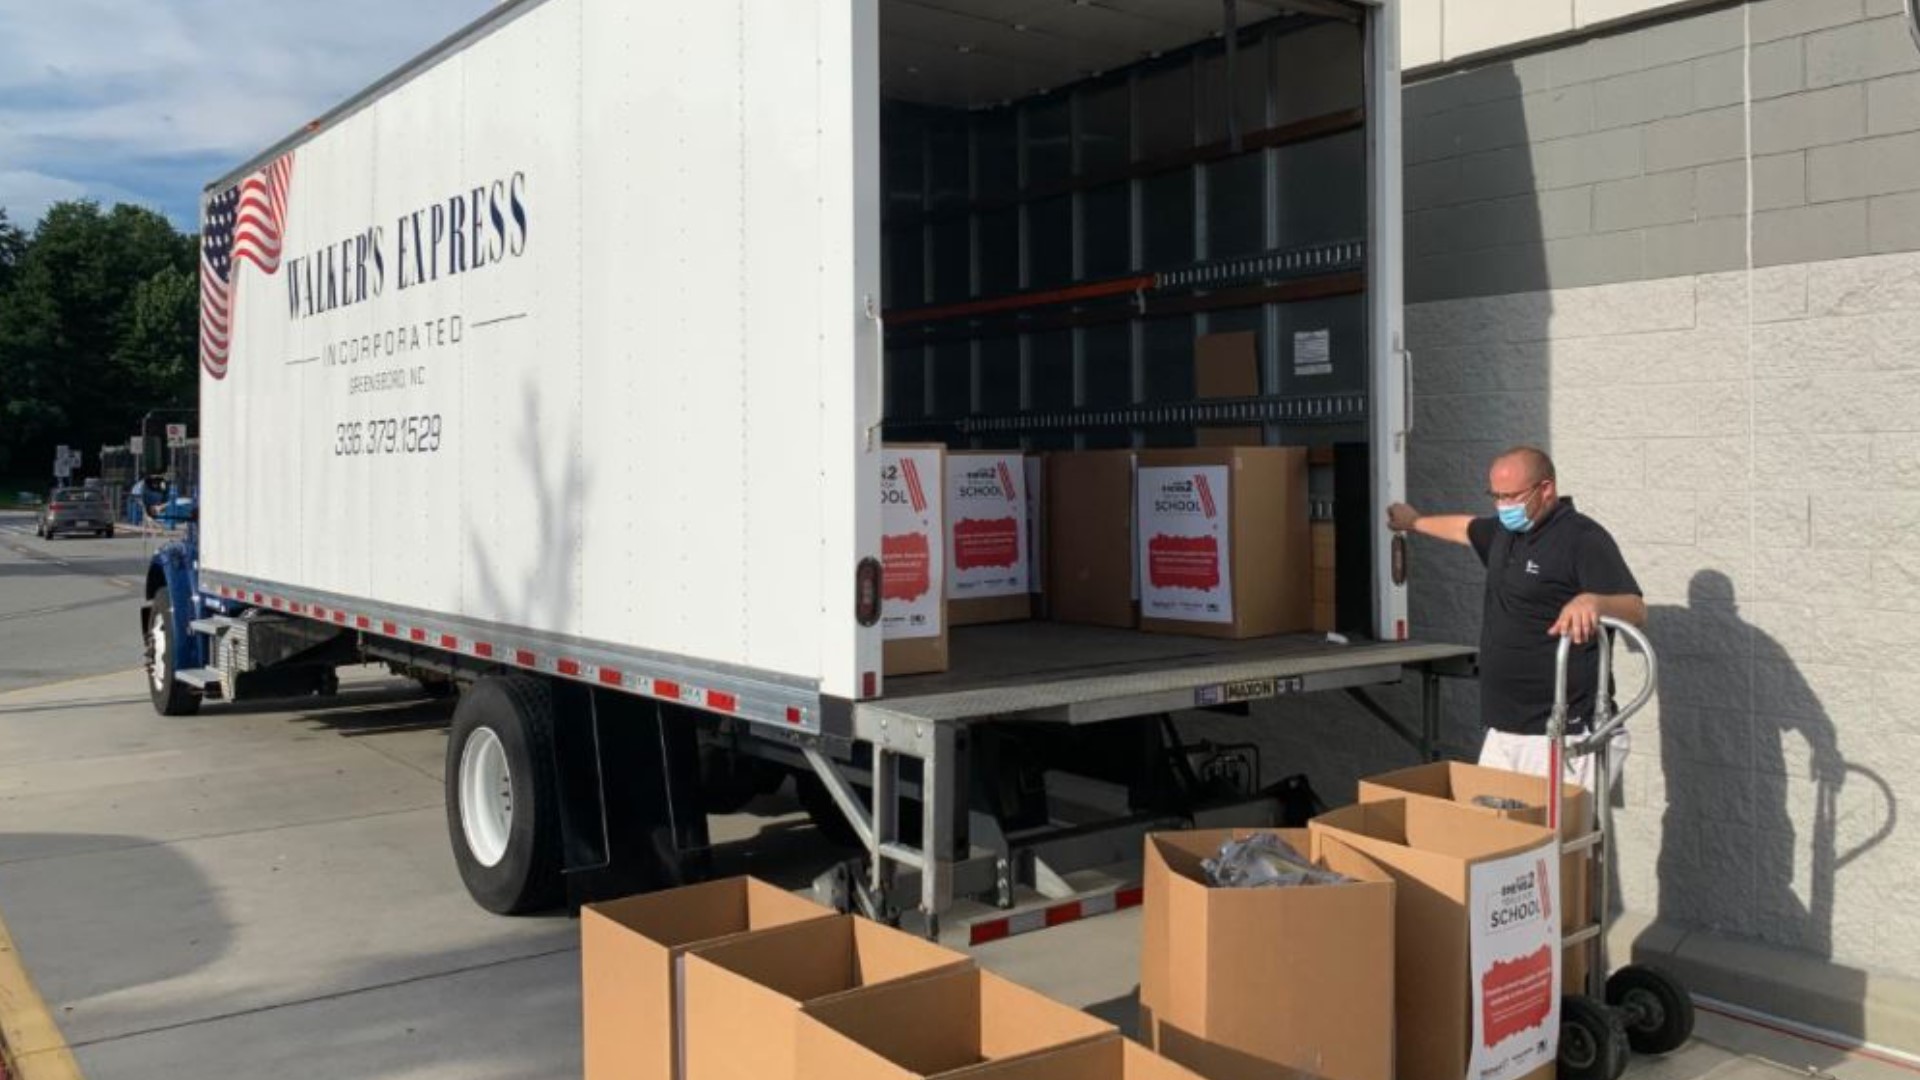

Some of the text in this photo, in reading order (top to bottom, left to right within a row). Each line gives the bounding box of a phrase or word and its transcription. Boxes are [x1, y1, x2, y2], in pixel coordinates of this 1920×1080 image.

[287, 171, 527, 321] WALKER'S EXPRESS
[323, 315, 462, 366] INCORPORATED
[410, 366, 425, 386] NC
[335, 413, 442, 456] 336.379.1529
[959, 485, 1004, 498] SCHOOL
[1155, 500, 1201, 512] SCHOOL
[1490, 897, 1541, 929] SCHOOL
